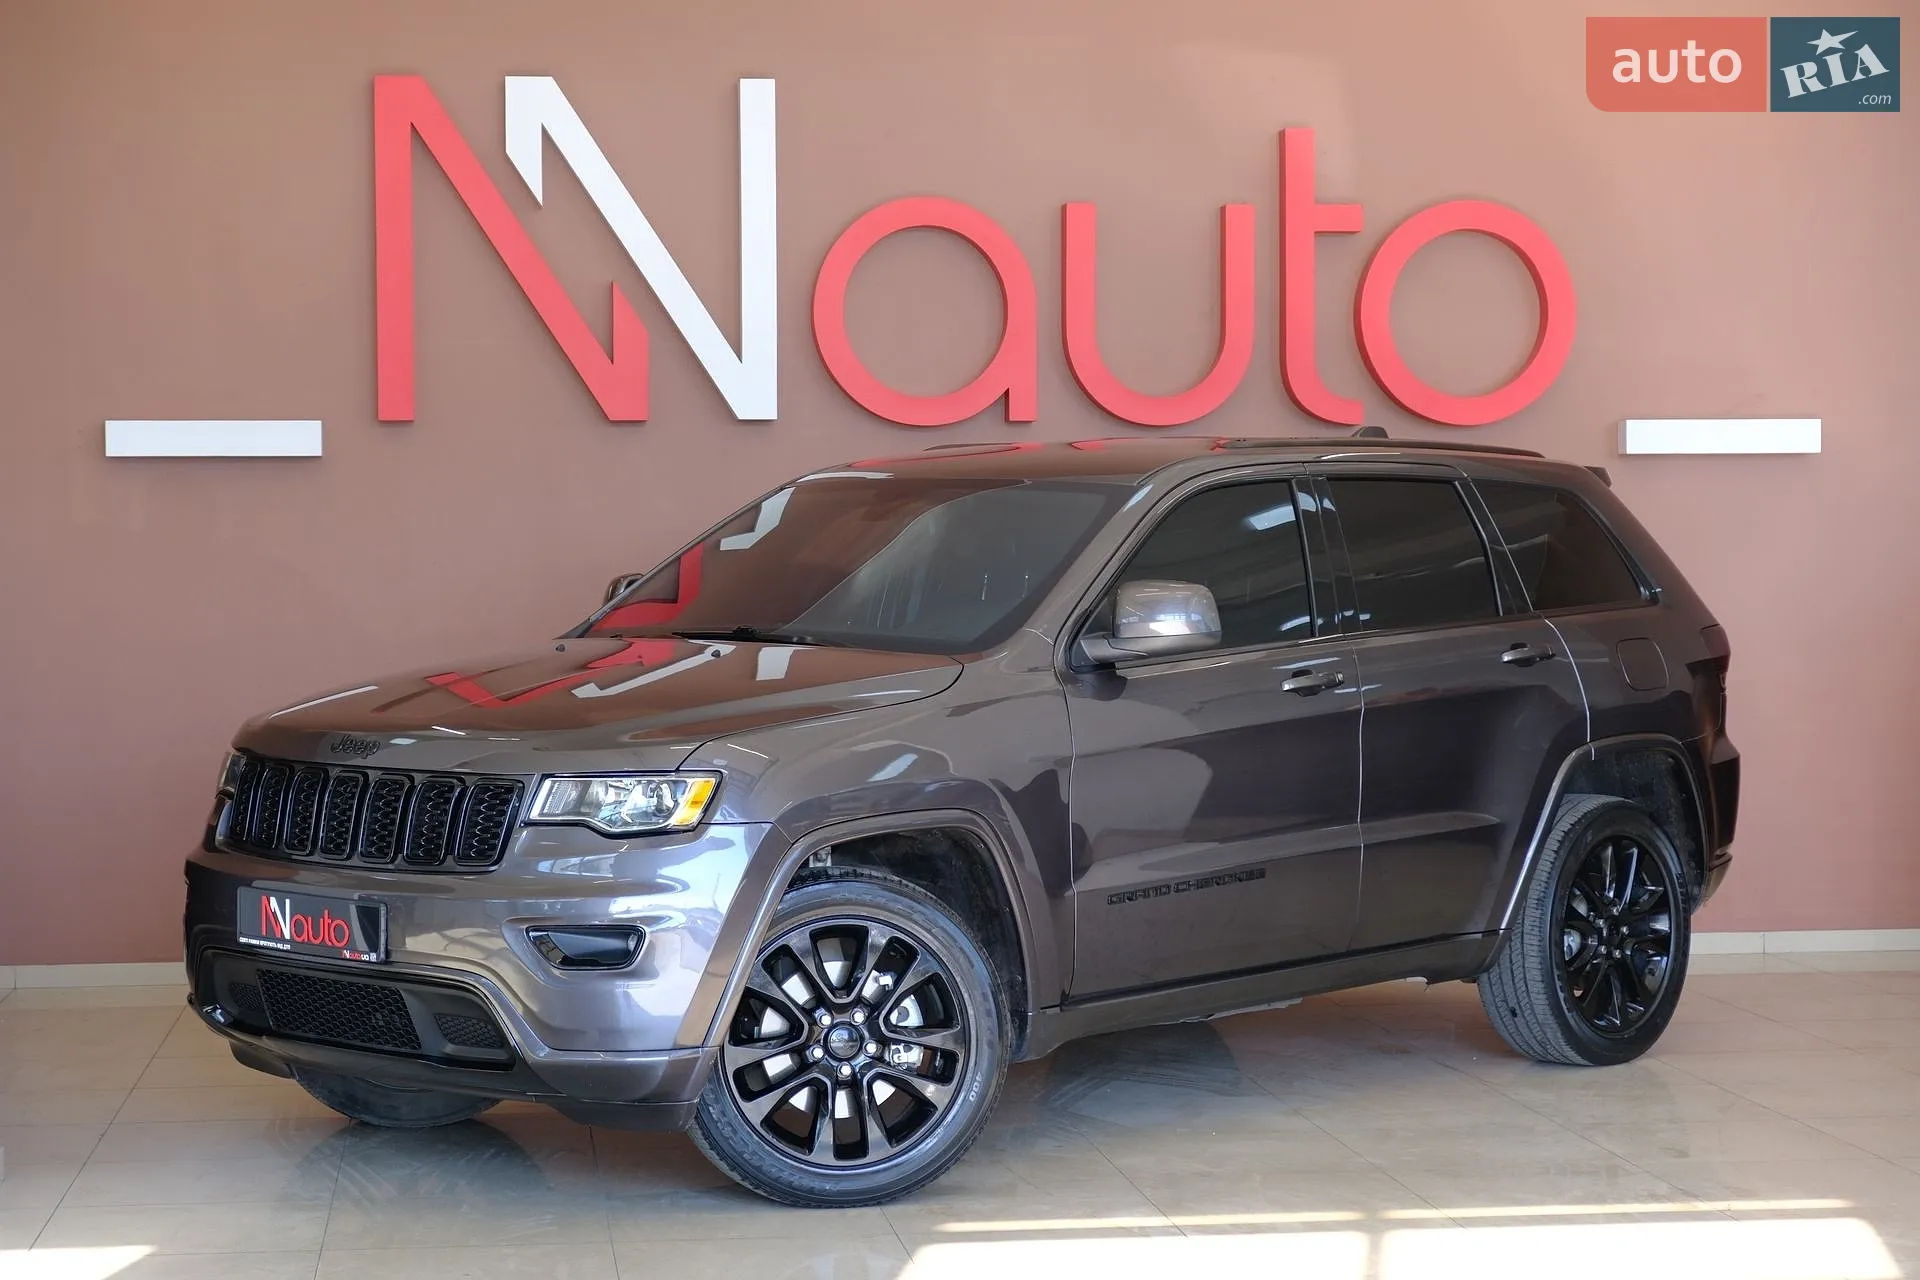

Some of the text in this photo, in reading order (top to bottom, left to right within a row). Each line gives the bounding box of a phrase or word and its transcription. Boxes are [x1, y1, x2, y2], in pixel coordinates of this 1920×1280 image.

[330, 734, 381, 760] Jeep
[1107, 868, 1266, 905] GRAND CHEROKEE
